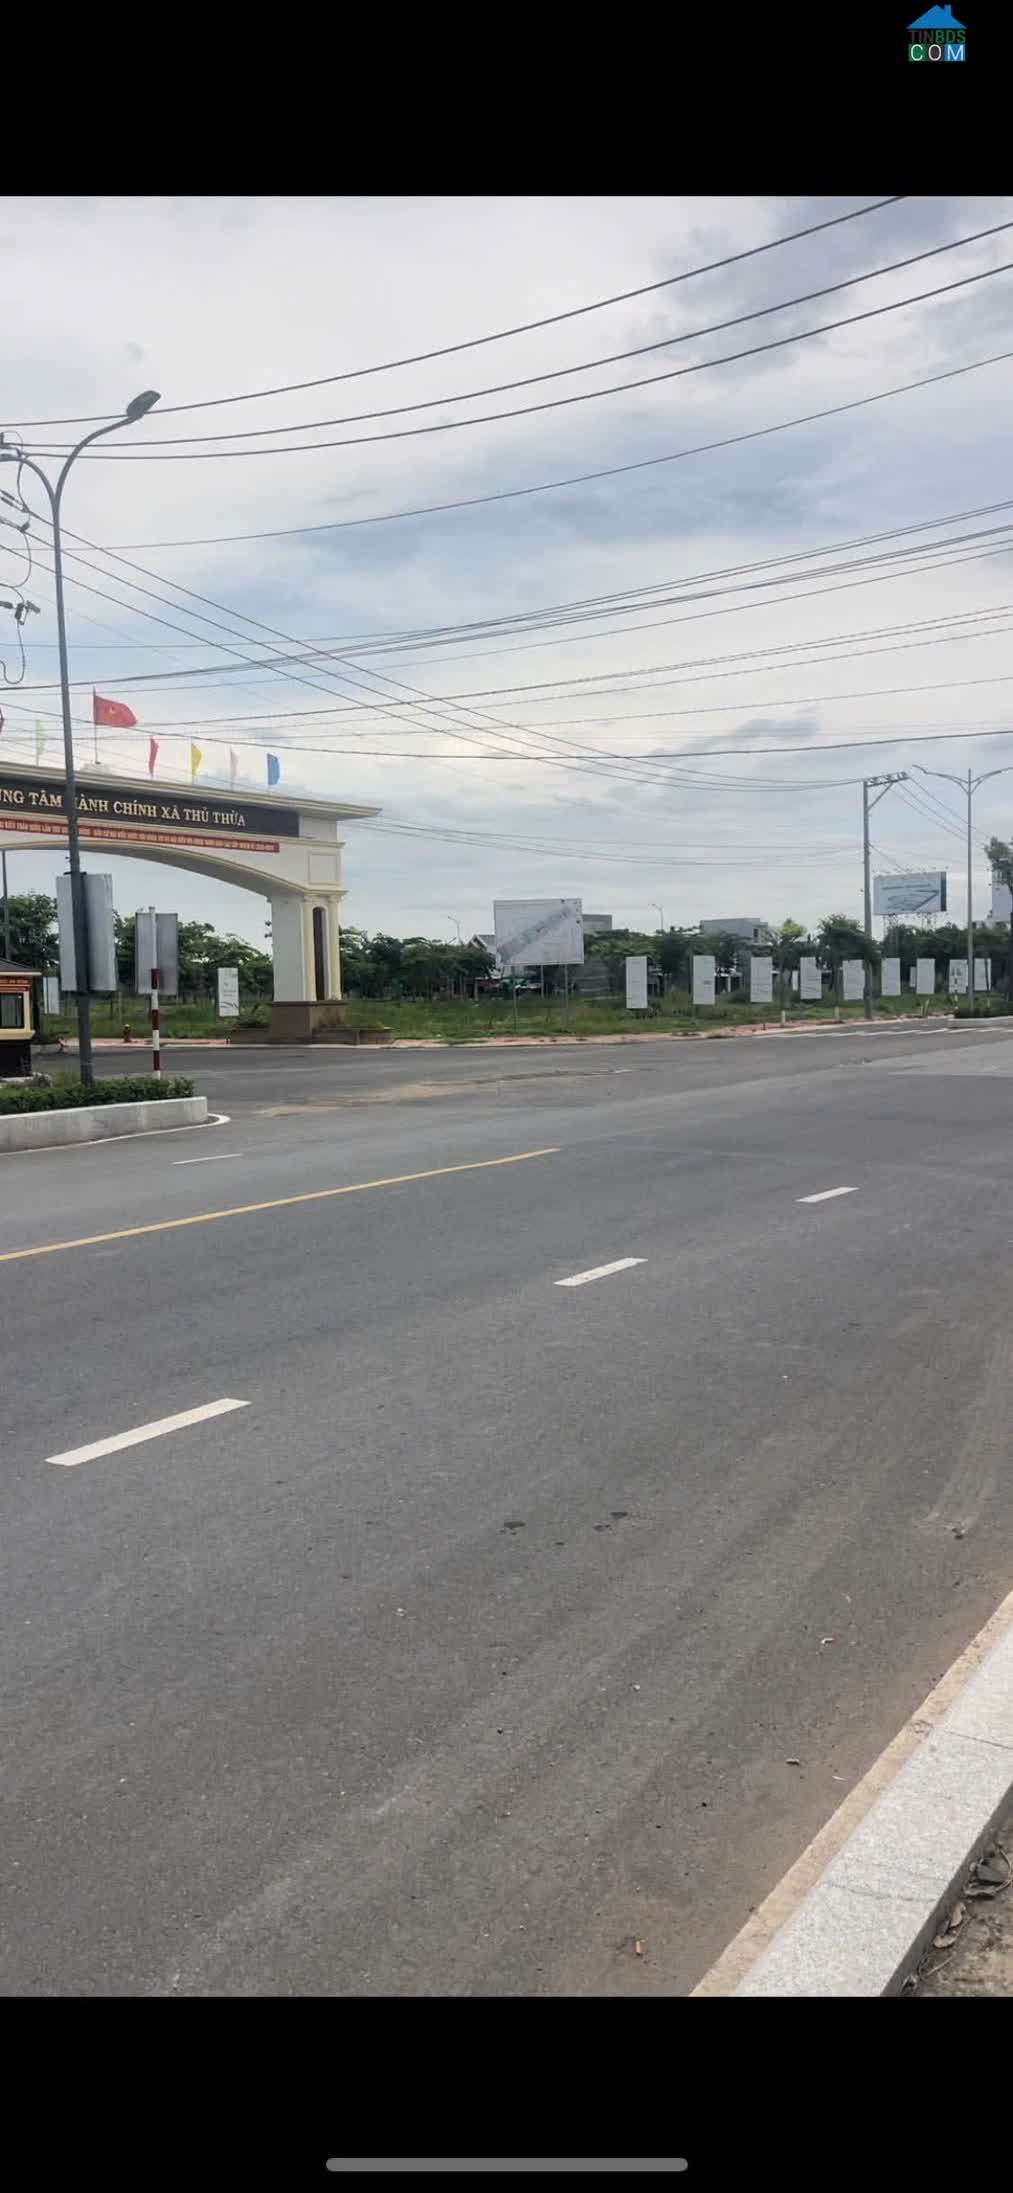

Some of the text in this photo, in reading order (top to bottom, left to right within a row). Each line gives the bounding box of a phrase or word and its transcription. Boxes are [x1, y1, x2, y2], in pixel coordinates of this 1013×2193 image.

[0, 789, 25, 804] NG
[28, 790, 63, 808] TÂM
[113, 800, 158, 818] CHÍNH
